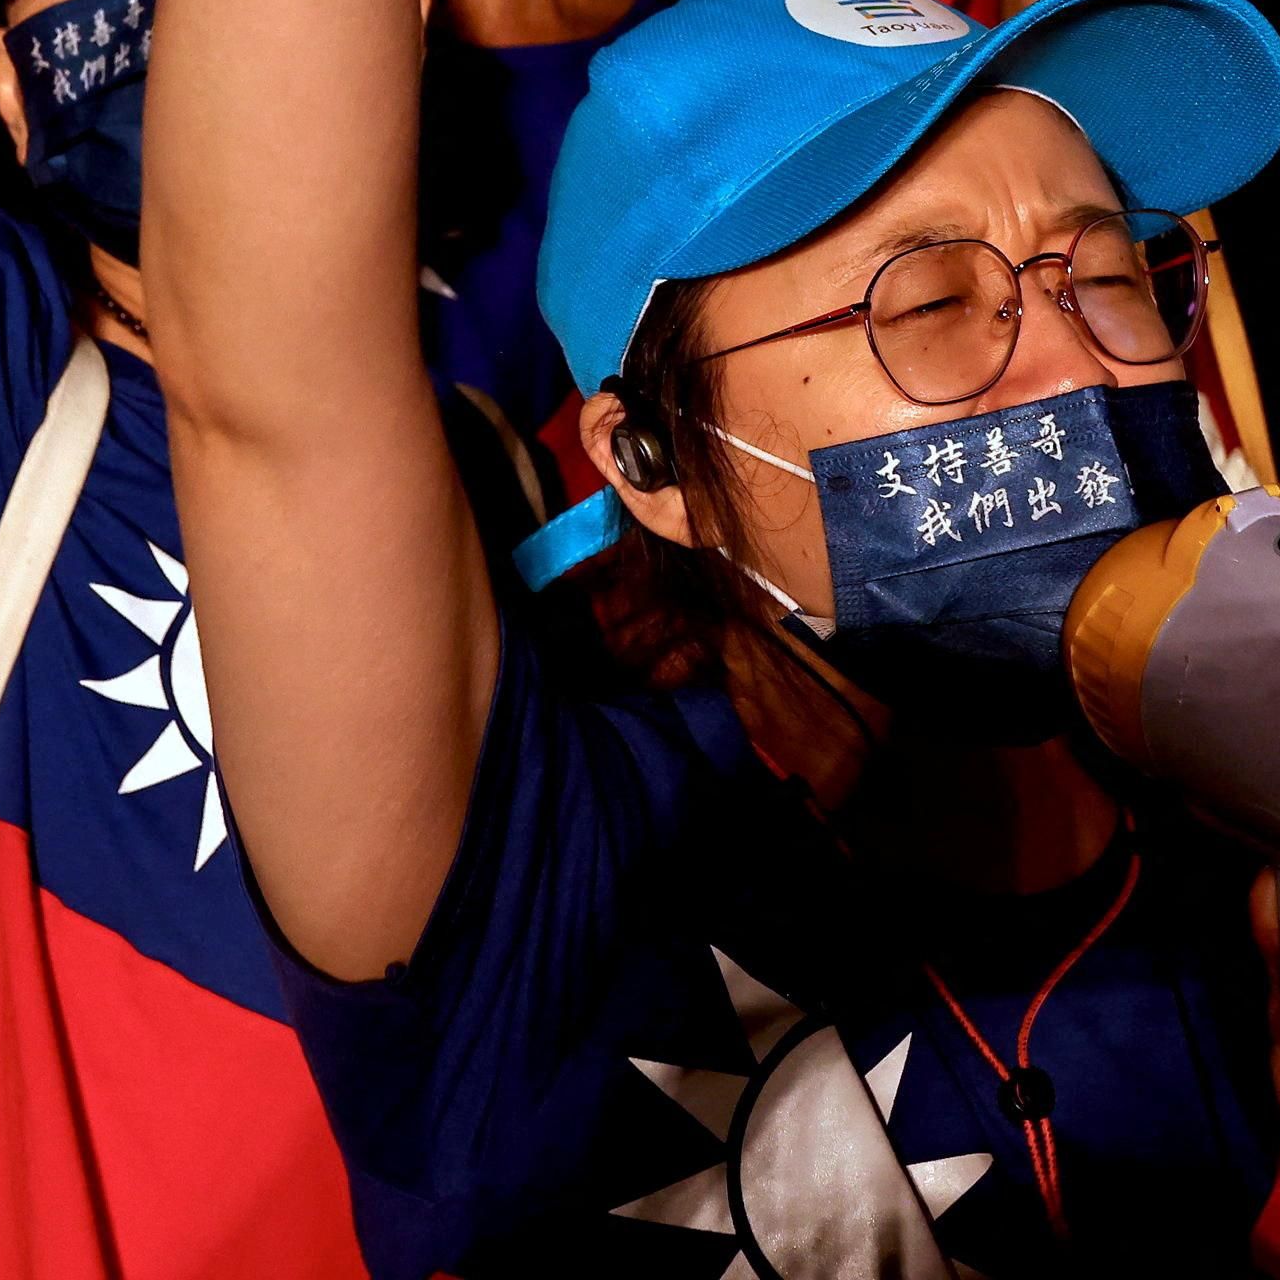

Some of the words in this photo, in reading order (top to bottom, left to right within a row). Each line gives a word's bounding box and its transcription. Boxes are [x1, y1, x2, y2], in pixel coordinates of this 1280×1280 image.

[860, 20, 956, 37] Taoyuan
[876, 413, 1066, 498] 支持善哥
